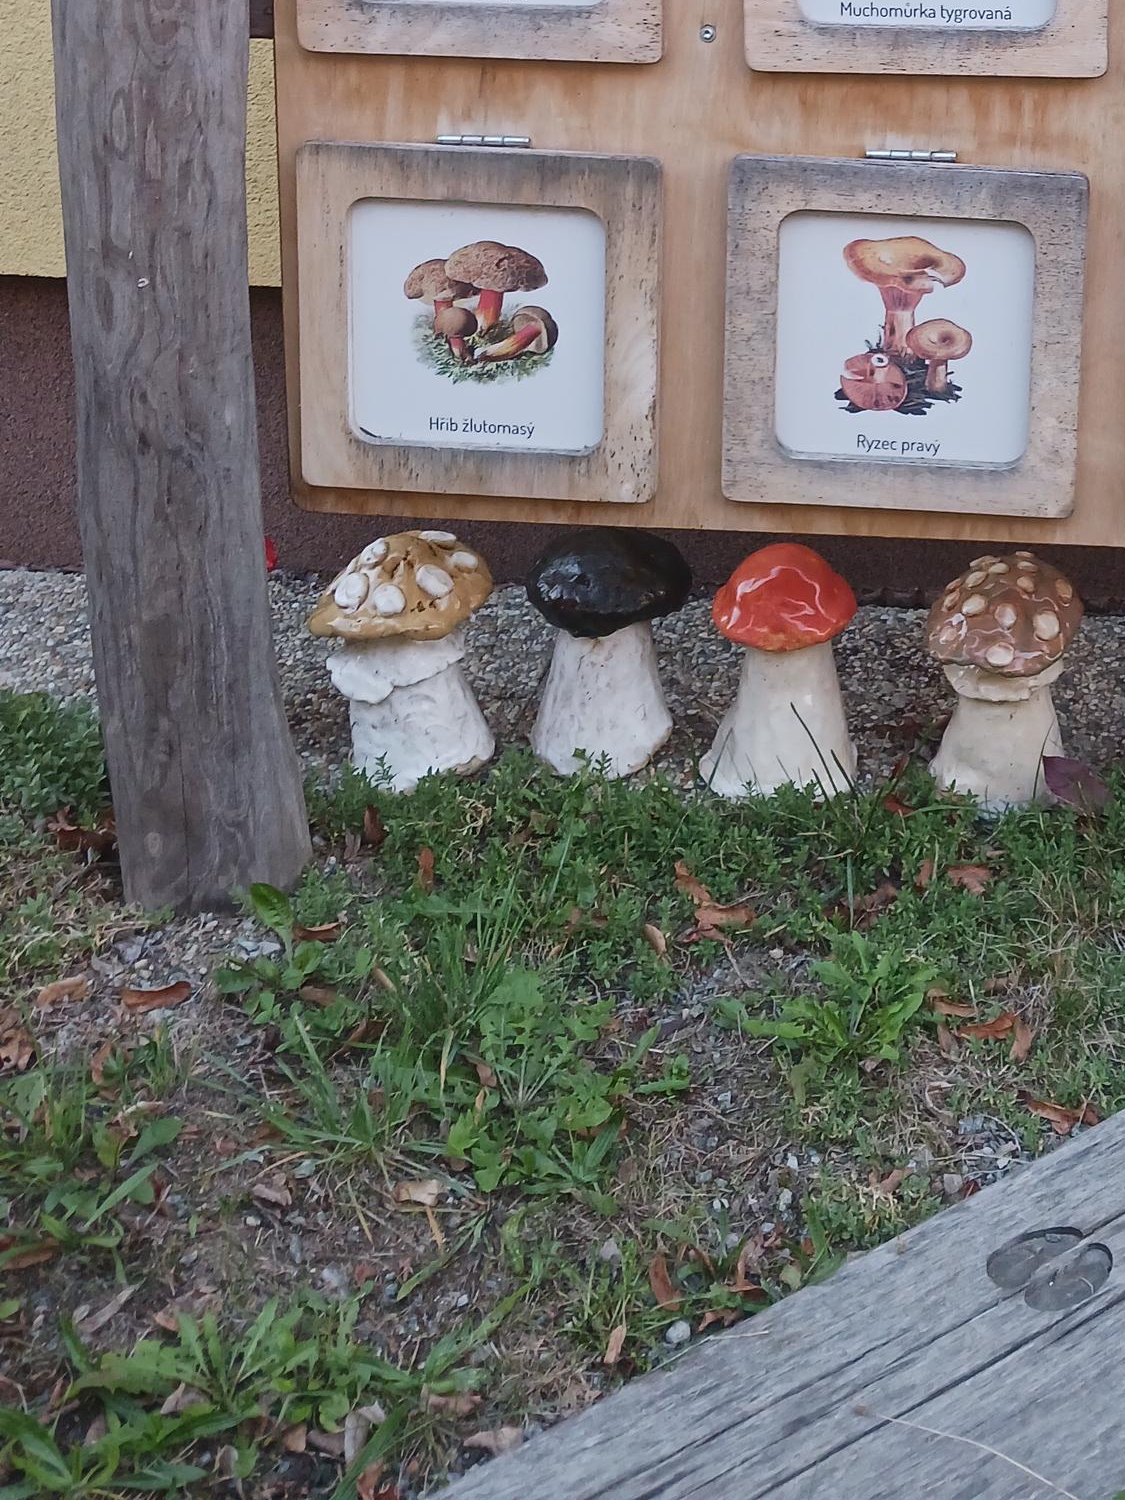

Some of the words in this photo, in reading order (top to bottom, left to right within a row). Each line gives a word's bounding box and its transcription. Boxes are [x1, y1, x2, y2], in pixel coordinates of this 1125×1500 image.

[840, 1, 937, 19] Muchomůrka
[940, 4, 1012, 24] tygrovaná
[429, 416, 459, 432] Hřib
[461, 417, 536, 440] žlutomasý
[856, 433, 898, 453] Ryzec
[901, 439, 941, 457] pravý
